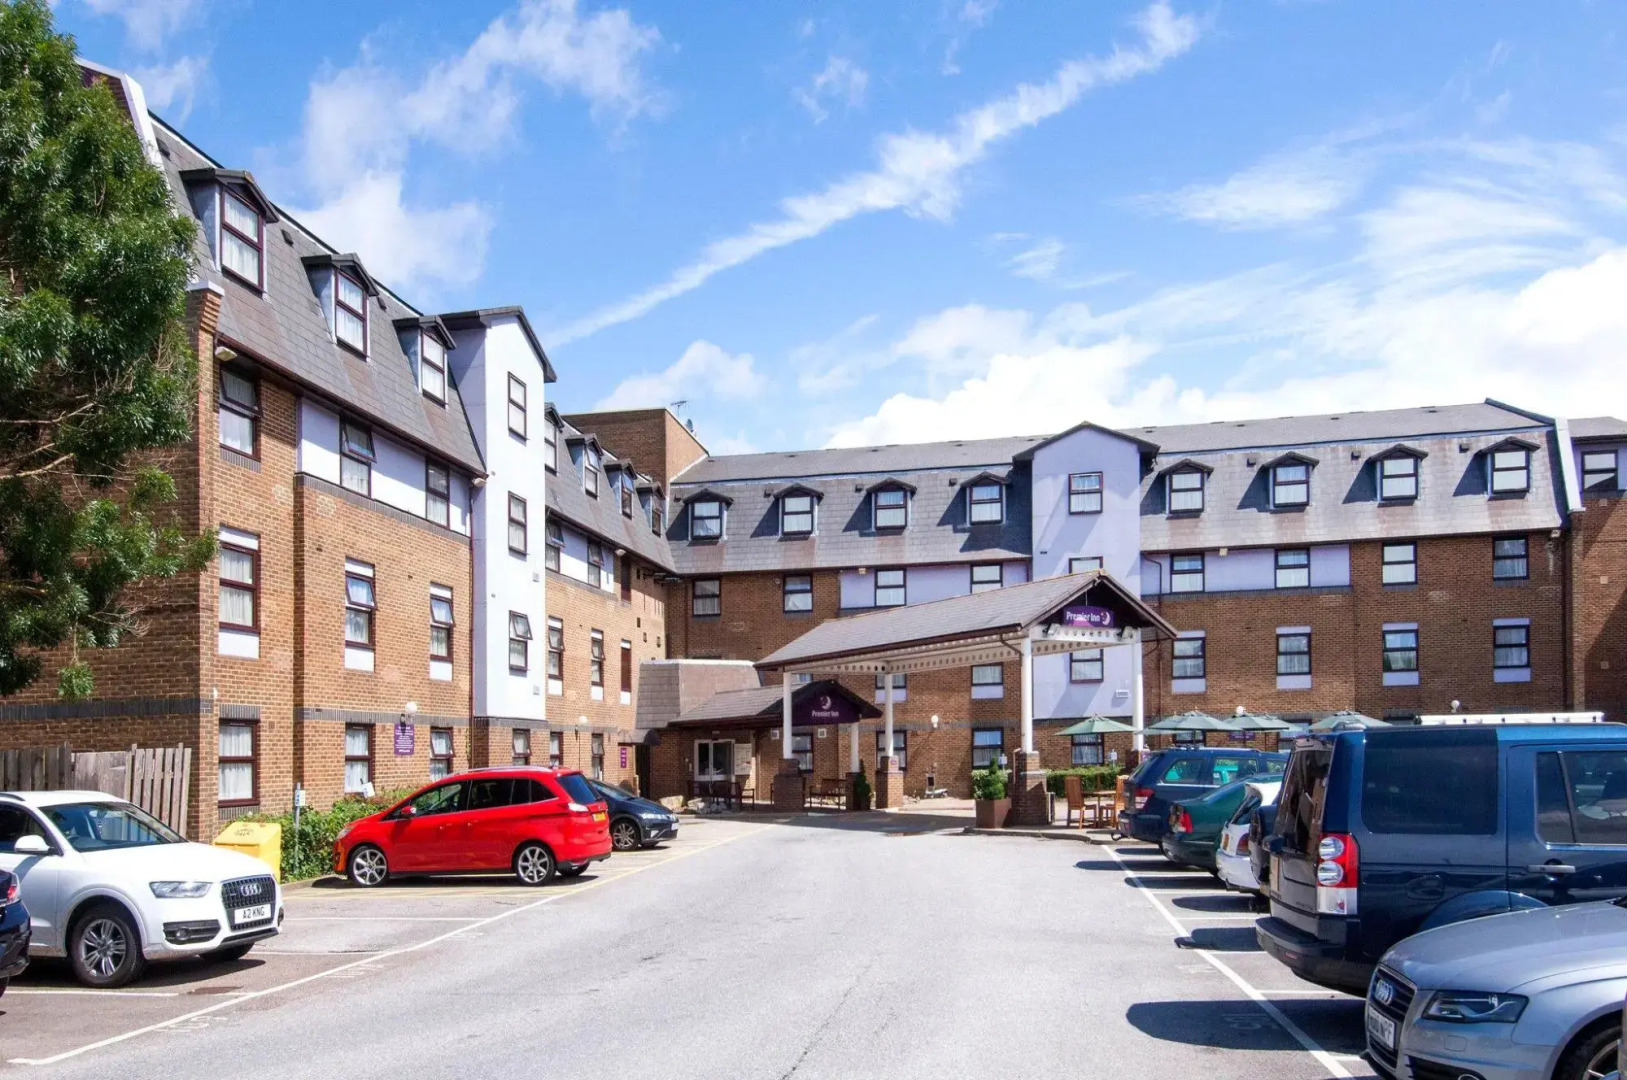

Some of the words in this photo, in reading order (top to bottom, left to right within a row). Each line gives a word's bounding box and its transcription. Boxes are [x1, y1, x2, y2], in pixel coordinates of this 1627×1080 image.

[1066, 611, 1090, 622] Premier
[1090, 612, 1101, 622] Inn
[242, 909, 252, 919] A2
[252, 906, 265, 917] KNG
